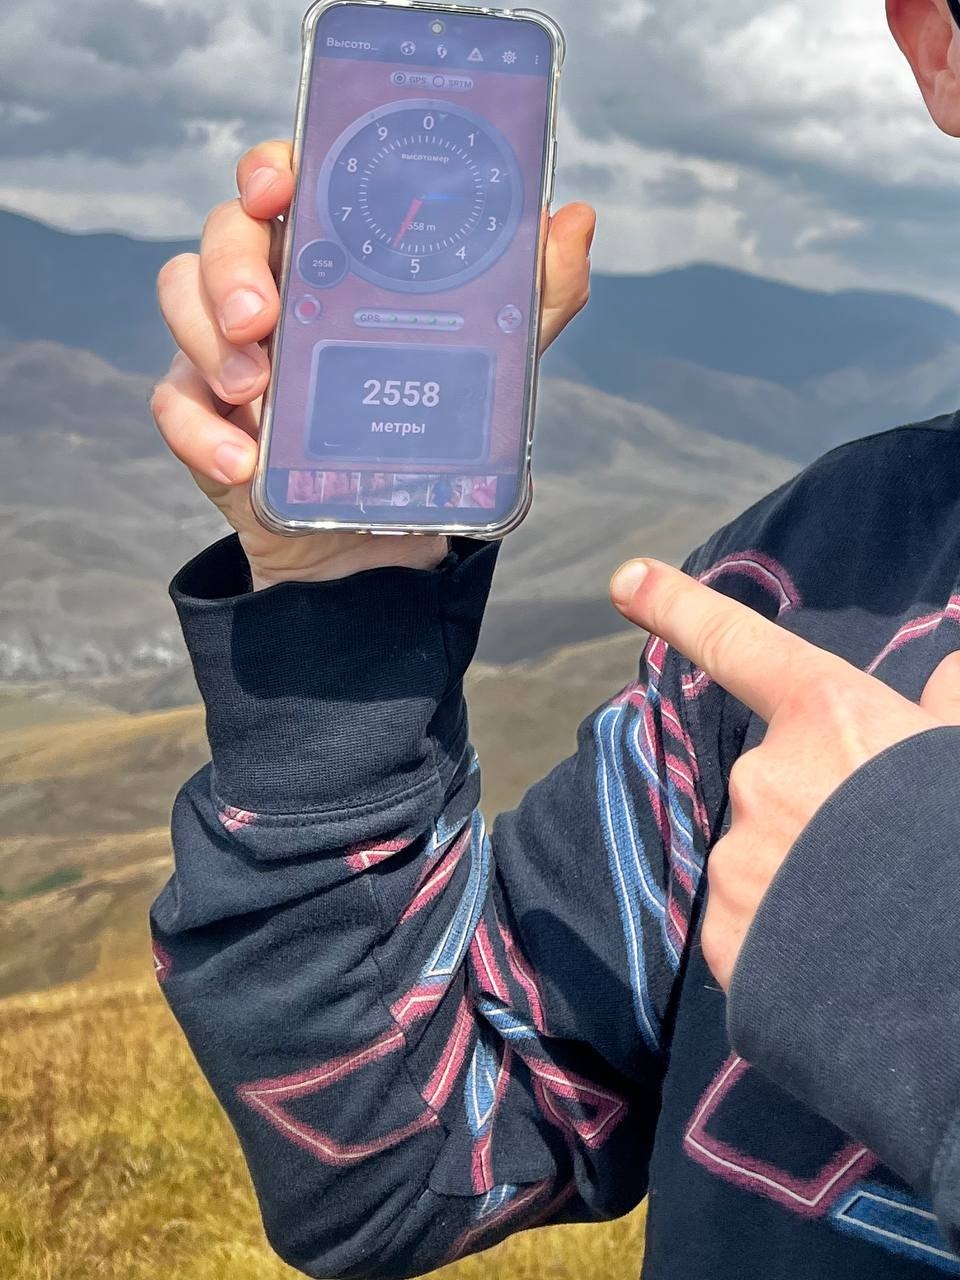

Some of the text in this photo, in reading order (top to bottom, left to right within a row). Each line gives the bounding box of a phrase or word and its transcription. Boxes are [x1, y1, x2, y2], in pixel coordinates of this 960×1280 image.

[423, 116, 434, 130] 0
[378, 127, 388, 141] 9
[468, 133, 475, 147] 1
[346, 158, 358, 172] 8
[490, 168, 501, 182] 2
[342, 207, 353, 221] 7
[487, 217, 497, 232] 3
[362, 240, 373, 254] 6
[455, 246, 467, 260] 4
[410, 259, 421, 274] 5
[361, 379, 440, 407] 2558
[371, 422, 426, 436] метры
